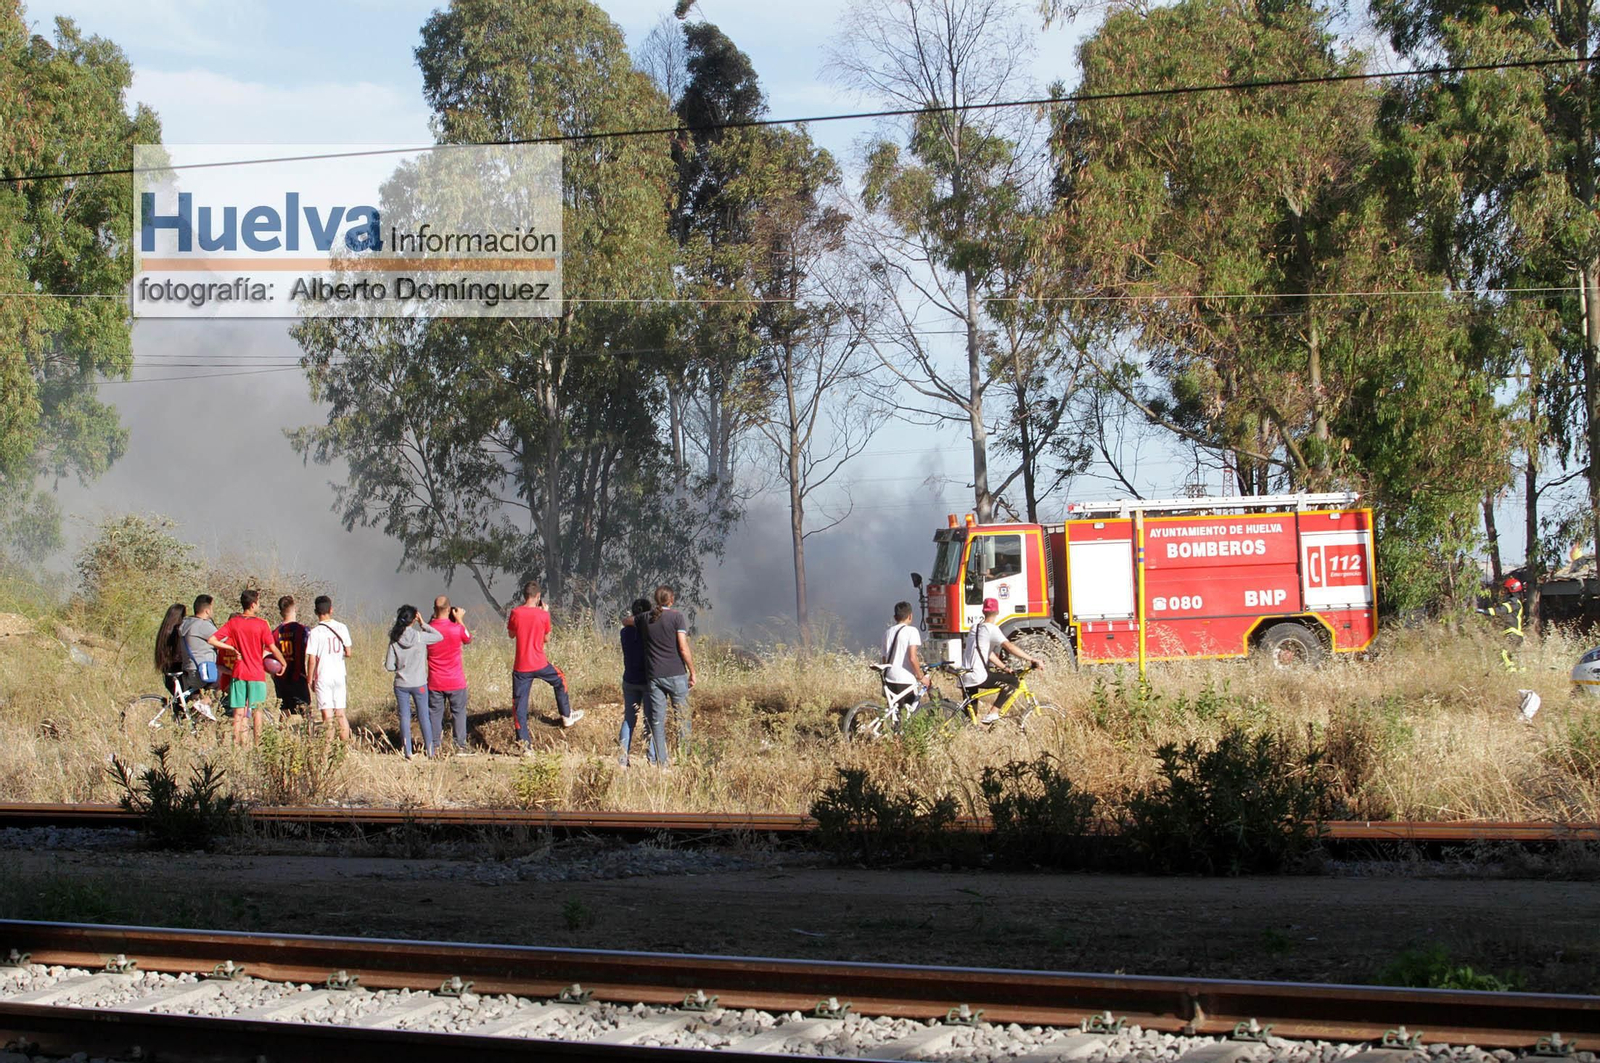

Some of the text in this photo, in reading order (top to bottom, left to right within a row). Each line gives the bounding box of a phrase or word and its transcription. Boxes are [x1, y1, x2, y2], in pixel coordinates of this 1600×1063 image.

[1149, 523, 1283, 538] AYUNTAMIENTO DE HUELVA
[1166, 539, 1266, 558] BOMBEROS
[1329, 554, 1361, 571] 112
[1169, 595, 1203, 610] 080
[1244, 589, 1287, 607] BNP
[328, 636, 341, 654] 10
